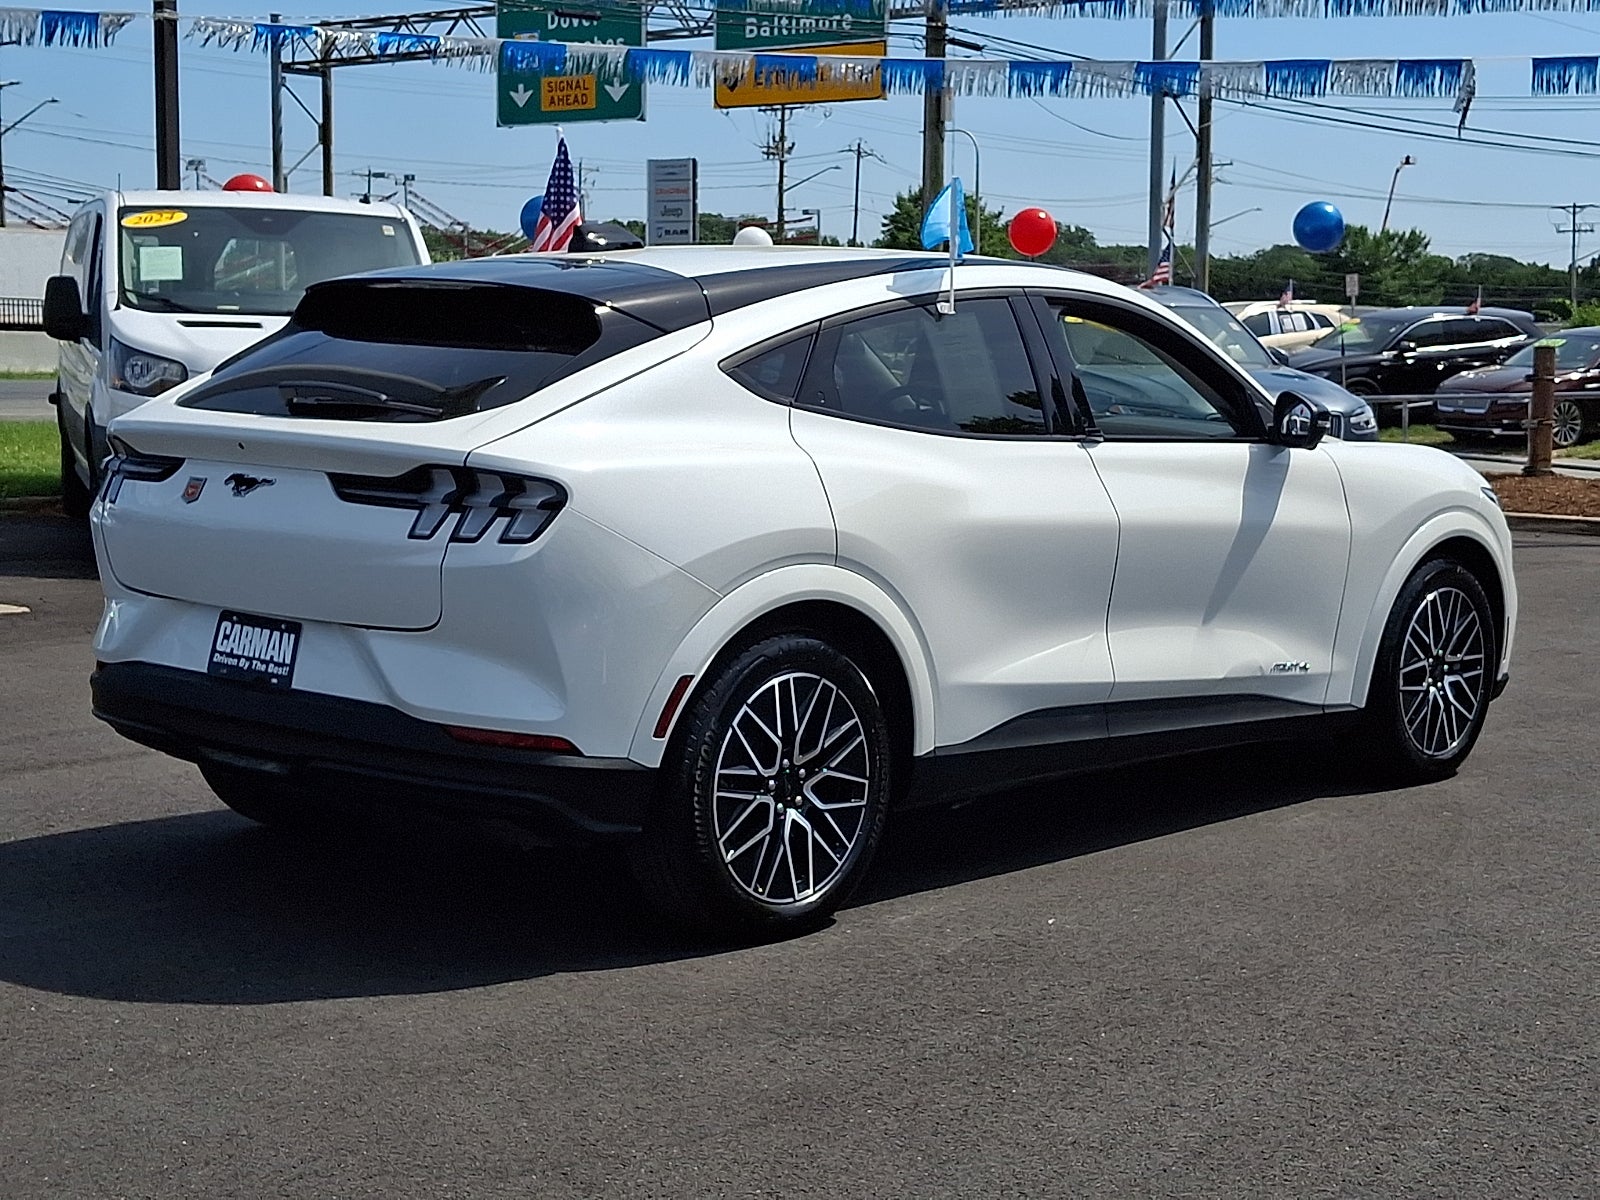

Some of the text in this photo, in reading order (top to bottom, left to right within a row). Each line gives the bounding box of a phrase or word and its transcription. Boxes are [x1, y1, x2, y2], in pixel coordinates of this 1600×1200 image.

[745, 13, 853, 38] Baltimore
[547, 79, 589, 93] SIGNAL
[548, 94, 589, 107] AHEAD
[133, 211, 175, 225] 2024
[216, 621, 295, 664] CARMAN
[213, 653, 290, 675] Driven By The Best!
